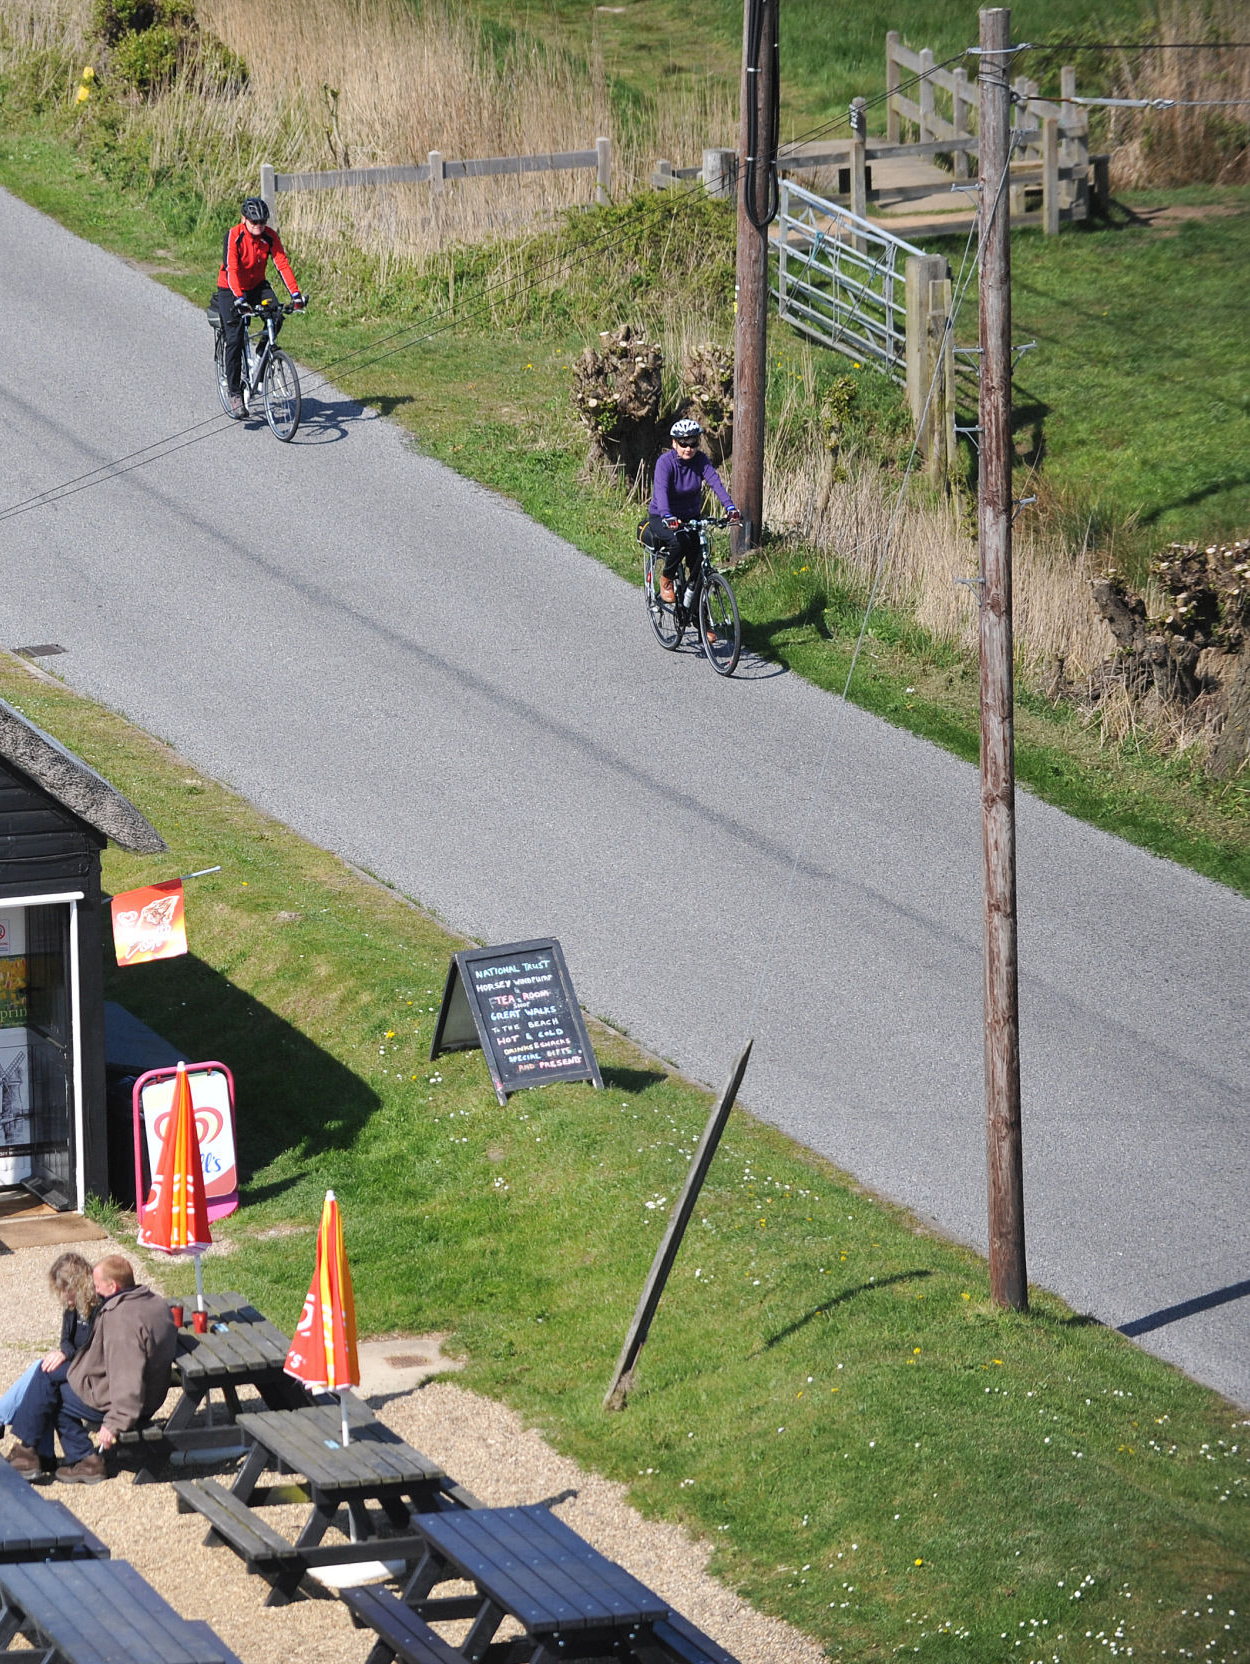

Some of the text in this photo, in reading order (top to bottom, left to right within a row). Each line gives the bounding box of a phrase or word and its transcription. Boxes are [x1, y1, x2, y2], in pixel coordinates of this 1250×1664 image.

[475, 960, 551, 979] NATIONAL TRUST
[475, 980, 511, 993] HORSEY
[495, 989, 550, 1006] TEA ROOM
[490, 1005, 557, 1021] GREAT WALKS
[502, 1023, 520, 1032] THE
[527, 1017, 559, 1028] BEACH
[496, 1034, 519, 1046] HOT
[503, 1043, 534, 1056] DRINKS
[539, 1037, 571, 1048] SNACKS
[508, 1052, 542, 1063] SPECIAL
[518, 1063, 535, 1072] AND
